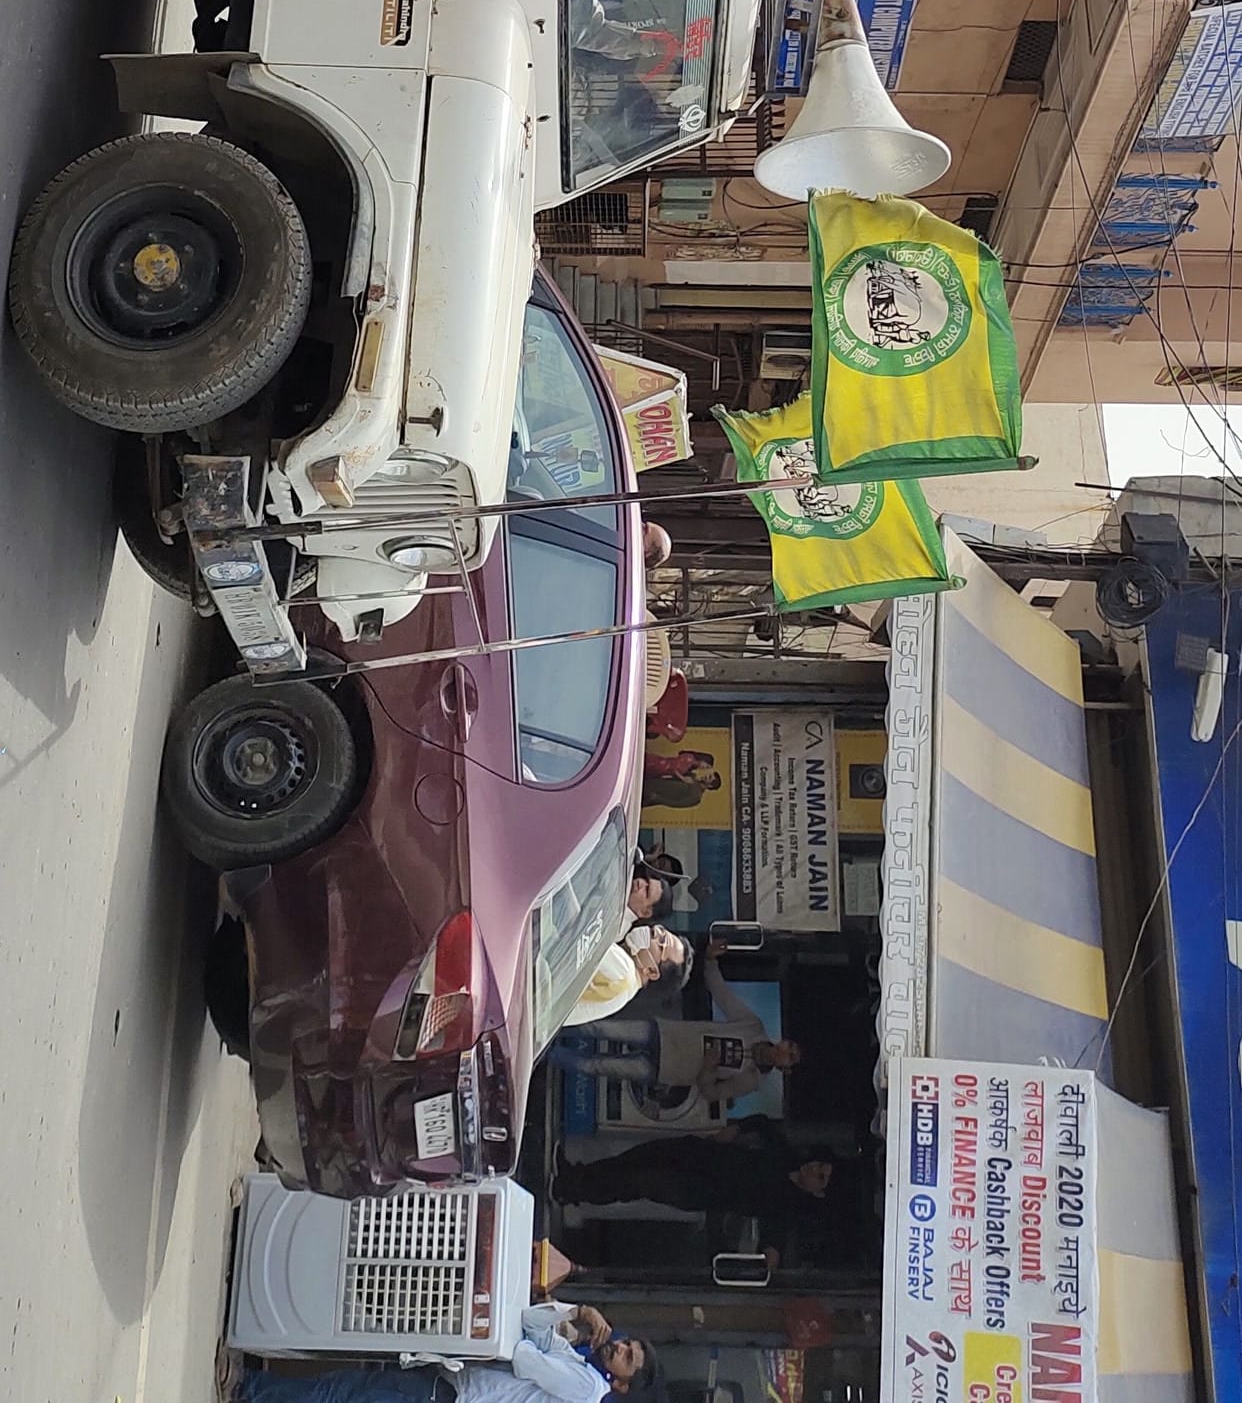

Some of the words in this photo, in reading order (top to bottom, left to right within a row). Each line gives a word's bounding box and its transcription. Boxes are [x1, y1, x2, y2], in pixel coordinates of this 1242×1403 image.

[868, 7, 903, 51] COMPUTER
[637, 402, 680, 466] OHAN
[740, 742, 751, 779] Naman
[891, 706, 930, 790] जैन
[741, 780, 752, 804] Jain
[805, 758, 828, 847] NAMAN
[808, 853, 830, 912] JAIN
[915, 1103, 934, 1146] HDB
[953, 1073, 979, 1108] 0%
[988, 1076, 1017, 1151] आकर्षक
[1022, 1080, 1046, 1169] लाजवाब
[1056, 1083, 1086, 1160] दीवाली
[951, 1115, 978, 1220] FINANCE
[1056, 1164, 1085, 1228] 2020
[949, 1226, 980, 1253] के
[985, 1157, 1013, 1259] Cashback
[1019, 1174, 1048, 1283] Discount
[907, 1226, 921, 1301] FINSERV
[922, 1227, 935, 1301] BAJAJ
[949, 1259, 974, 1319] साथ
[984, 1265, 1011, 1329] Offers
[1052, 1235, 1088, 1320] मनाइये
